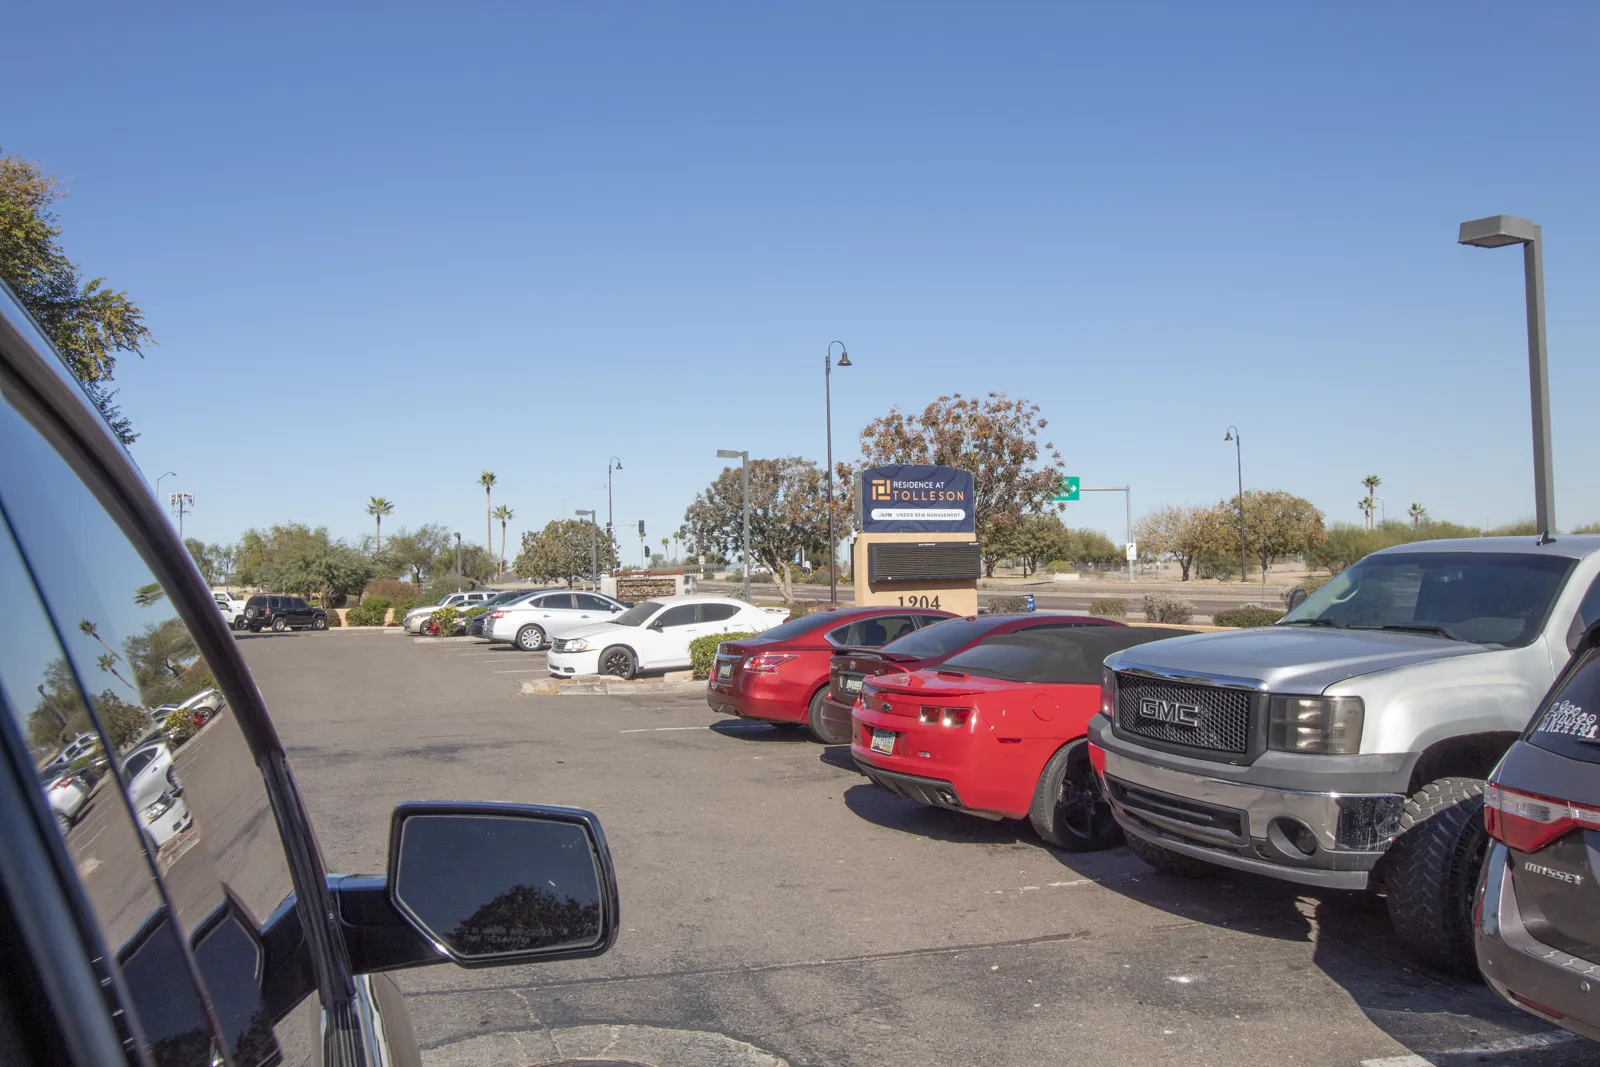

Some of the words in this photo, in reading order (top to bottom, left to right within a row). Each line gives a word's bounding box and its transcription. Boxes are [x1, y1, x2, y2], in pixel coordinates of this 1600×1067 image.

[893, 490, 964, 500] TOLLESON
[898, 595, 940, 610] 1204
[1140, 698, 1198, 727] GMC
[1524, 862, 1584, 885] ODYSSEY
